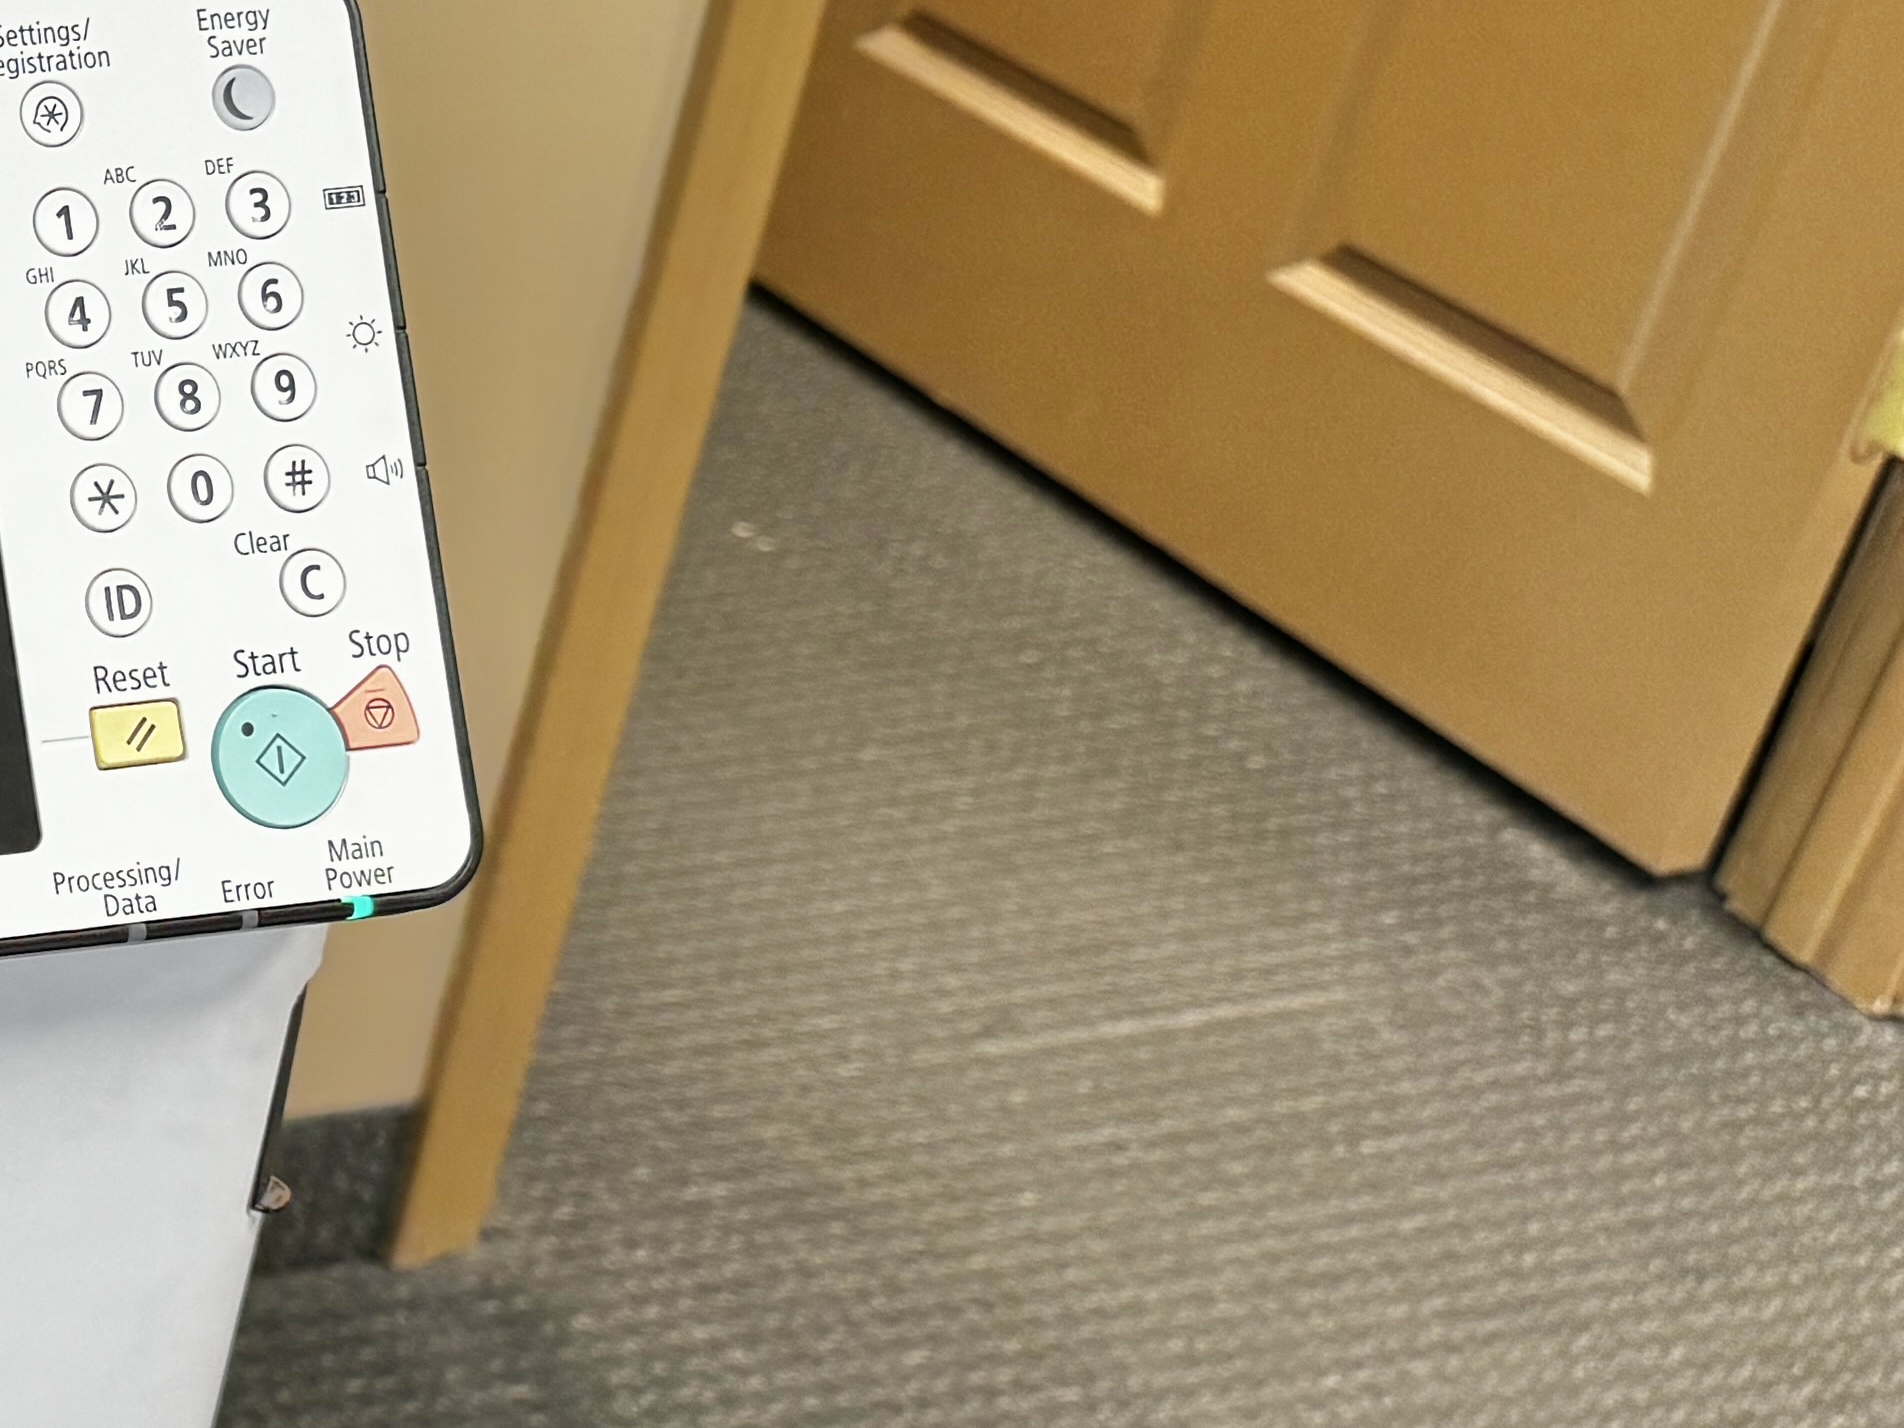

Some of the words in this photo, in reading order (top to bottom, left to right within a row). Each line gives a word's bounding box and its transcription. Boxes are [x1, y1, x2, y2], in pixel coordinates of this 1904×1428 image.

[197, 9, 269, 32] Energy
[207, 36, 266, 58] Saver
[104, 166, 136, 184] ABC
[205, 157, 233, 175] DEF
[152, 196, 176, 231] 2
[250, 188, 271, 222] 3
[56, 205, 73, 240] 1
[123, 258, 150, 275] JKL
[208, 249, 247, 267] MNO
[26, 267, 54, 284] GHI
[167, 287, 187, 323] 5
[261, 278, 282, 313] 6
[68, 296, 91, 331] 4
[131, 349, 162, 367] TUV
[212, 340, 260, 359] WXYZ
[26, 359, 66, 379] PQRS
[178, 379, 201, 415] 8
[275, 370, 295, 404] 9
[83, 388, 103, 425] 7
[191, 470, 213, 505] 0
[285, 460, 312, 496] #
[234, 531, 289, 555] Clear
[301, 565, 324, 600] C
[104, 584, 141, 621] ID
[349, 630, 409, 661] Stop
[93, 662, 170, 694] Reset
[234, 647, 301, 678] Start
[328, 836, 383, 862] Main
[53, 858, 180, 894] Processing/
[221, 880, 274, 903] Error
[326, 866, 394, 890] Power
[104, 894, 157, 917] Data
